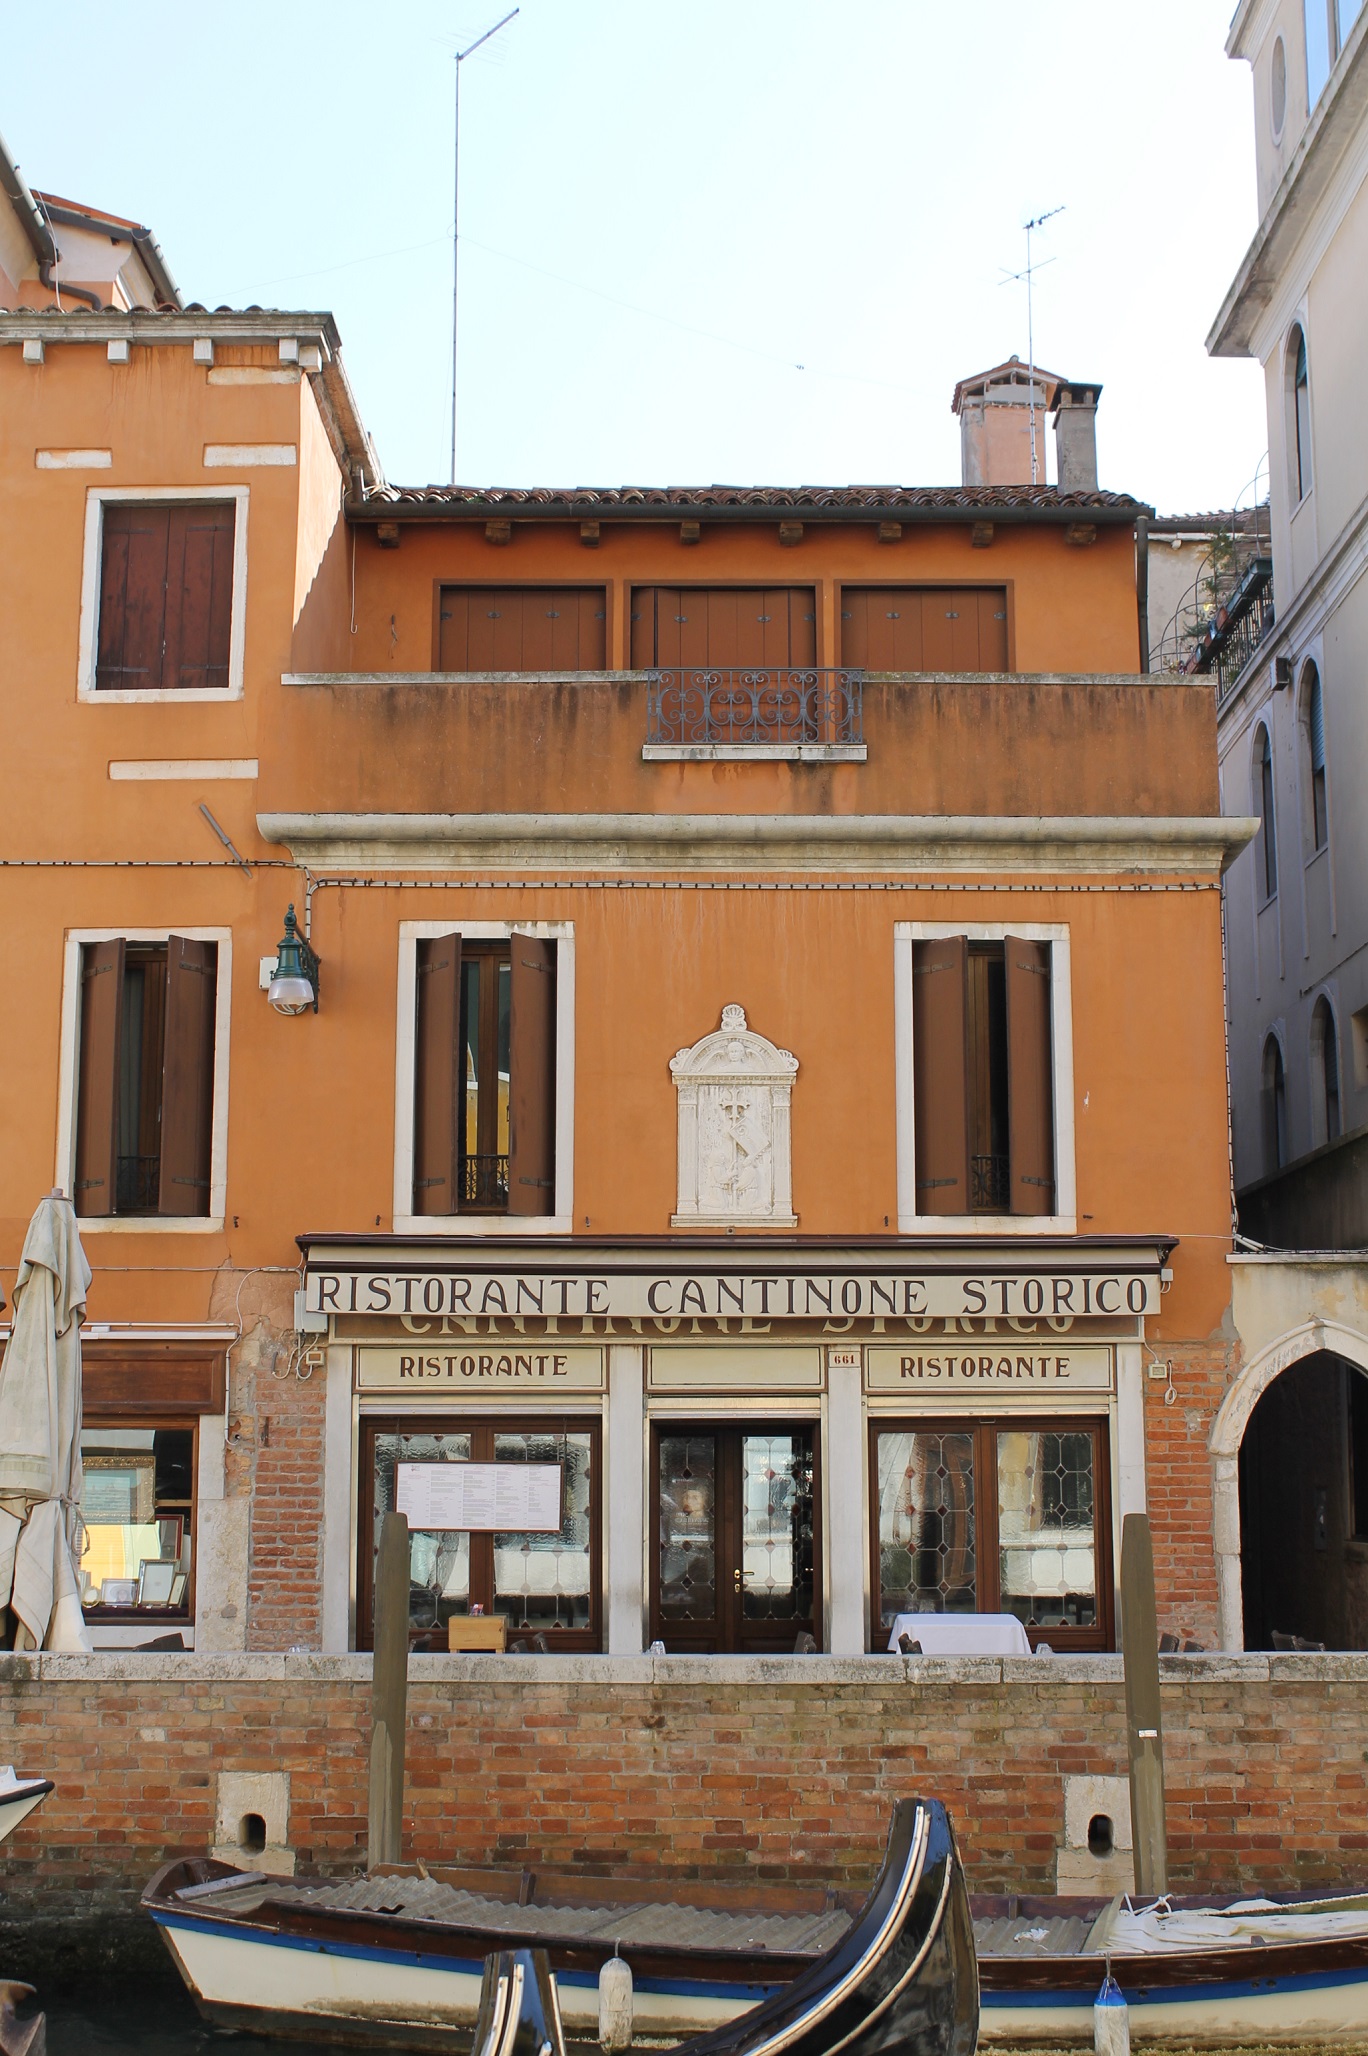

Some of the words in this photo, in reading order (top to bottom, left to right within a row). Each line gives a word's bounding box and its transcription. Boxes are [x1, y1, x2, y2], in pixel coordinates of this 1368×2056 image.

[318, 1276, 611, 1315] RISTORANTE
[647, 1278, 929, 1315] CANTINONE
[961, 1278, 1148, 1315] STORICO
[399, 1355, 568, 1378] RISTORANTE
[834, 1354, 856, 1365] 661
[900, 1356, 1071, 1379] RISTORANTE
